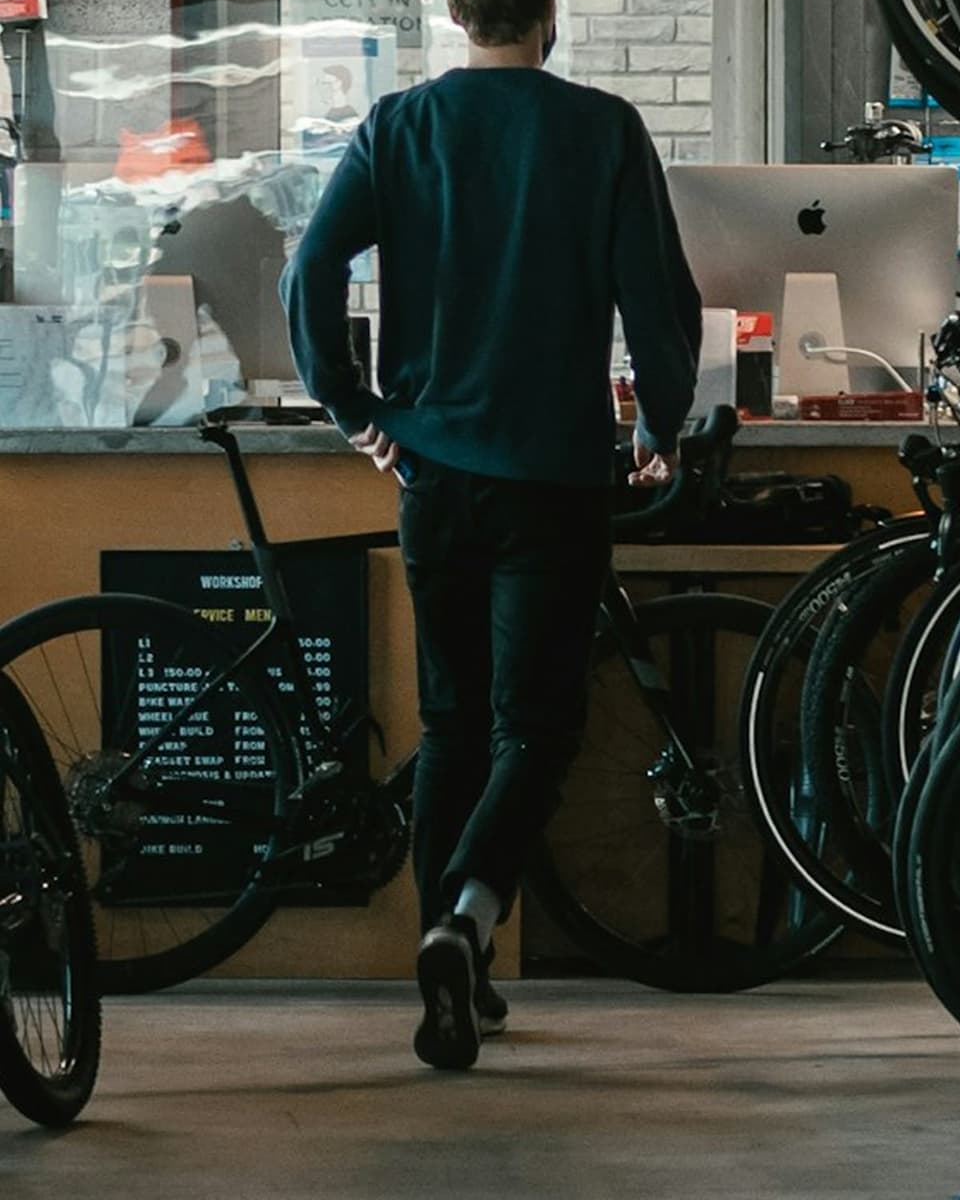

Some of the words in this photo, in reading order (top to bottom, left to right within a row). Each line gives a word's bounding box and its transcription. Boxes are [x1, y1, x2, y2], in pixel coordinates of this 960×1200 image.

[244, 608, 272, 622] MEN
[138, 682, 198, 693] PUNCTURE
[234, 711, 259, 722] FRO
